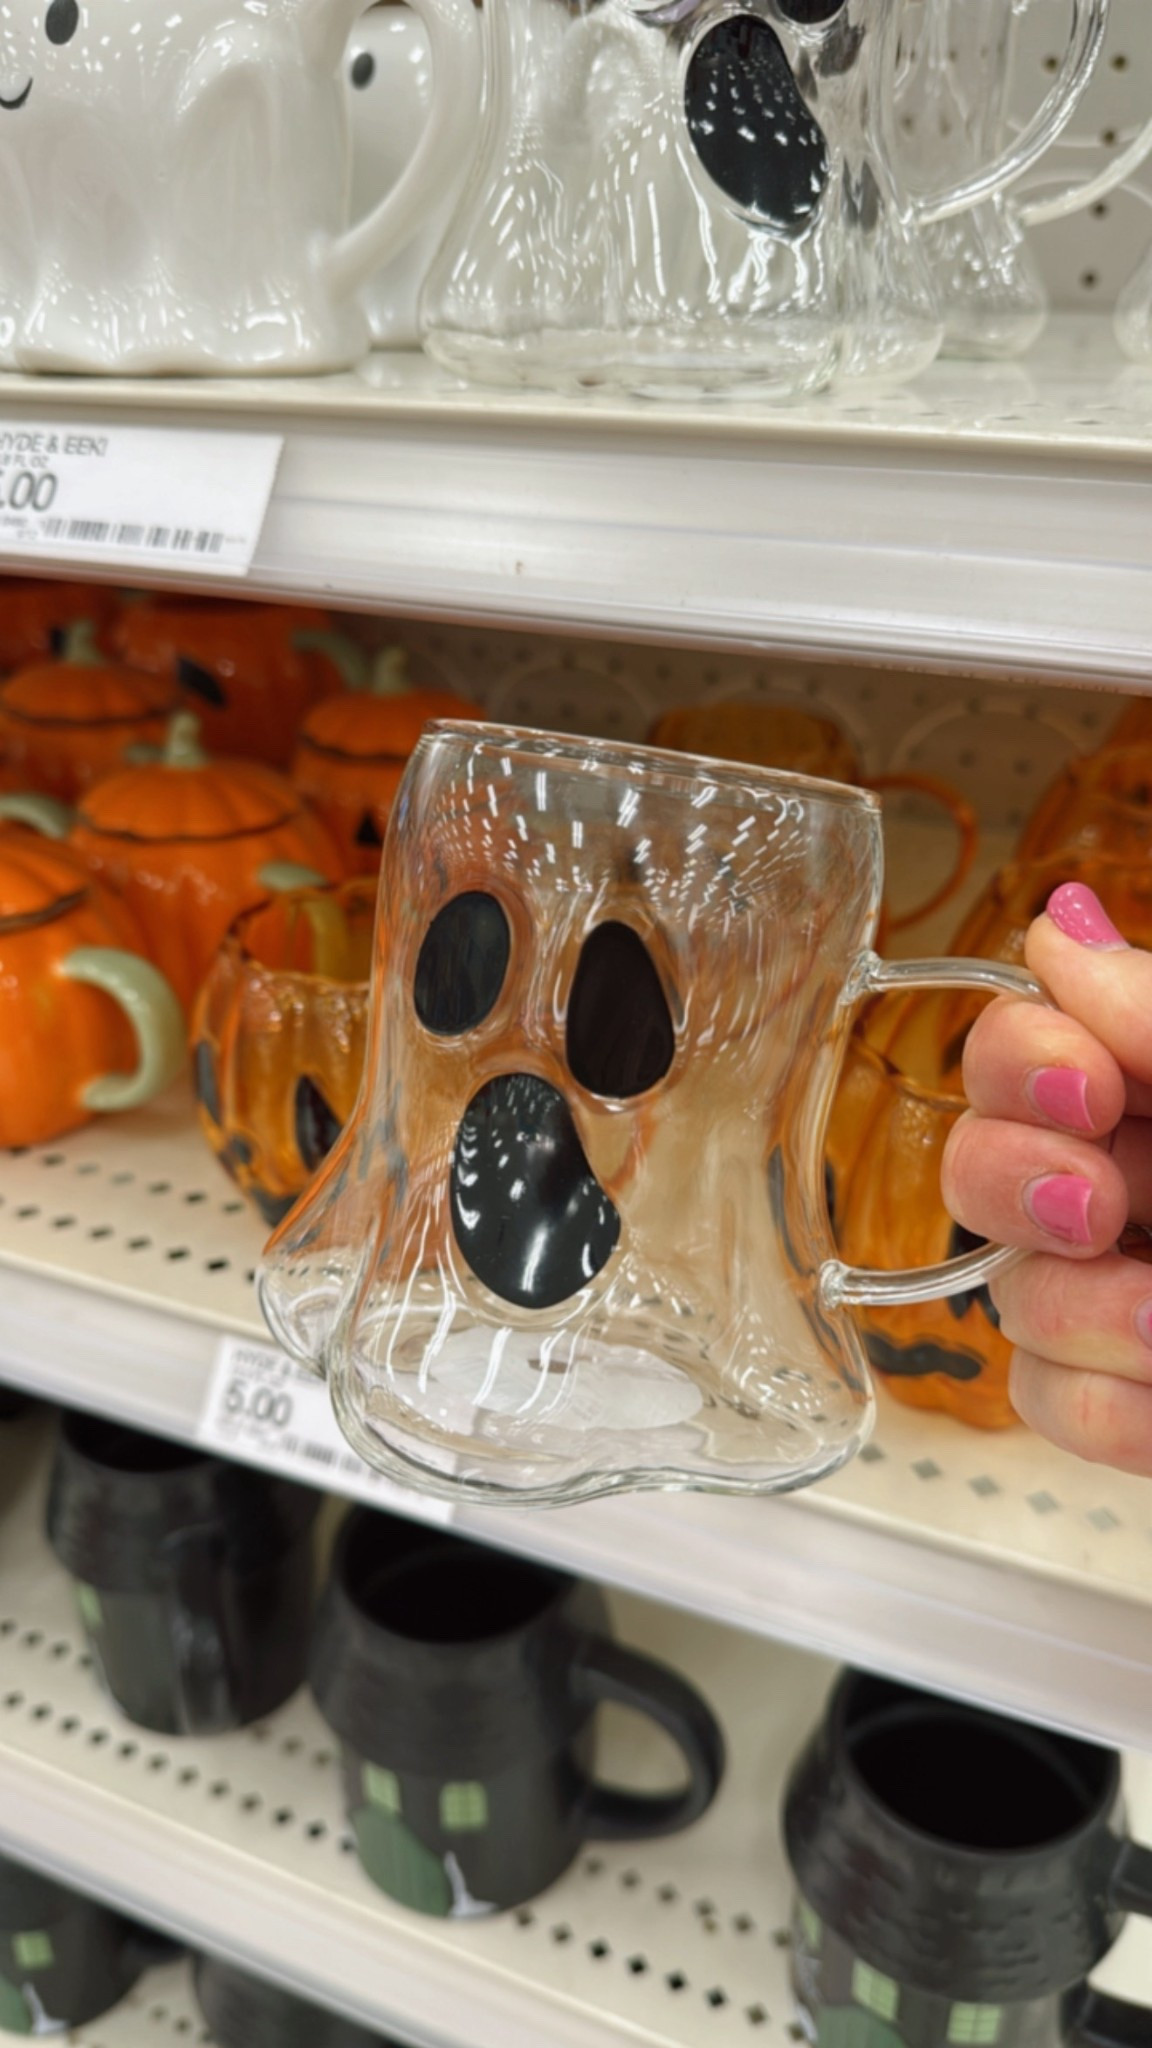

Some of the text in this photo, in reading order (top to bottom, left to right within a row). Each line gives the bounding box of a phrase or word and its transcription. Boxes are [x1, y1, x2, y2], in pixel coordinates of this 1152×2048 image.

[46, 434, 59, 454] &
[0, 470, 58, 513] .00
[225, 1379, 295, 1428] 5.00
